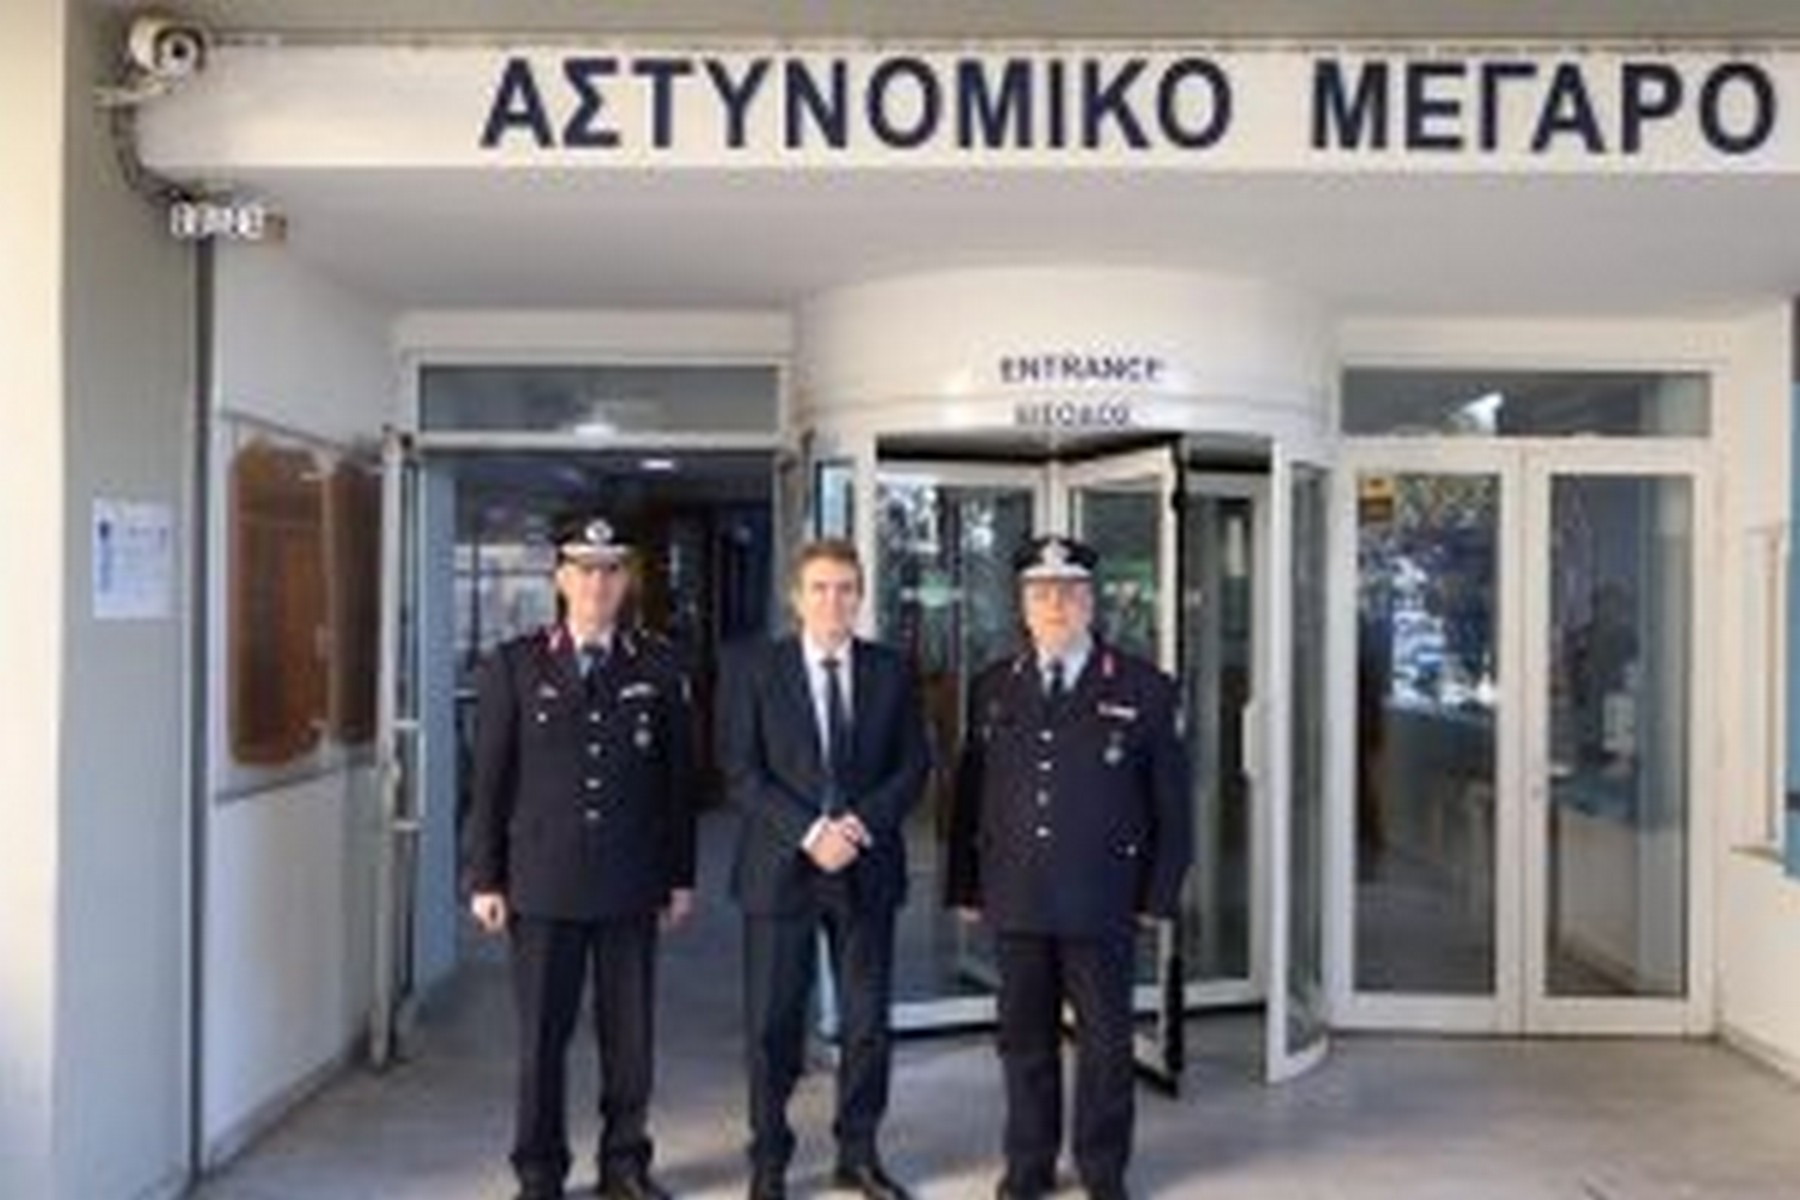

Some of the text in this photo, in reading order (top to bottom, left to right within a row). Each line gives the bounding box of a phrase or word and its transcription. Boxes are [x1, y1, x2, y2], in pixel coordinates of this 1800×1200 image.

[481, 57, 1777, 154] ΑΣΤΥΝΟΜΙΚΟ ΜΕΓΑΡΟ
[999, 355, 1164, 382] ENTRANCE
